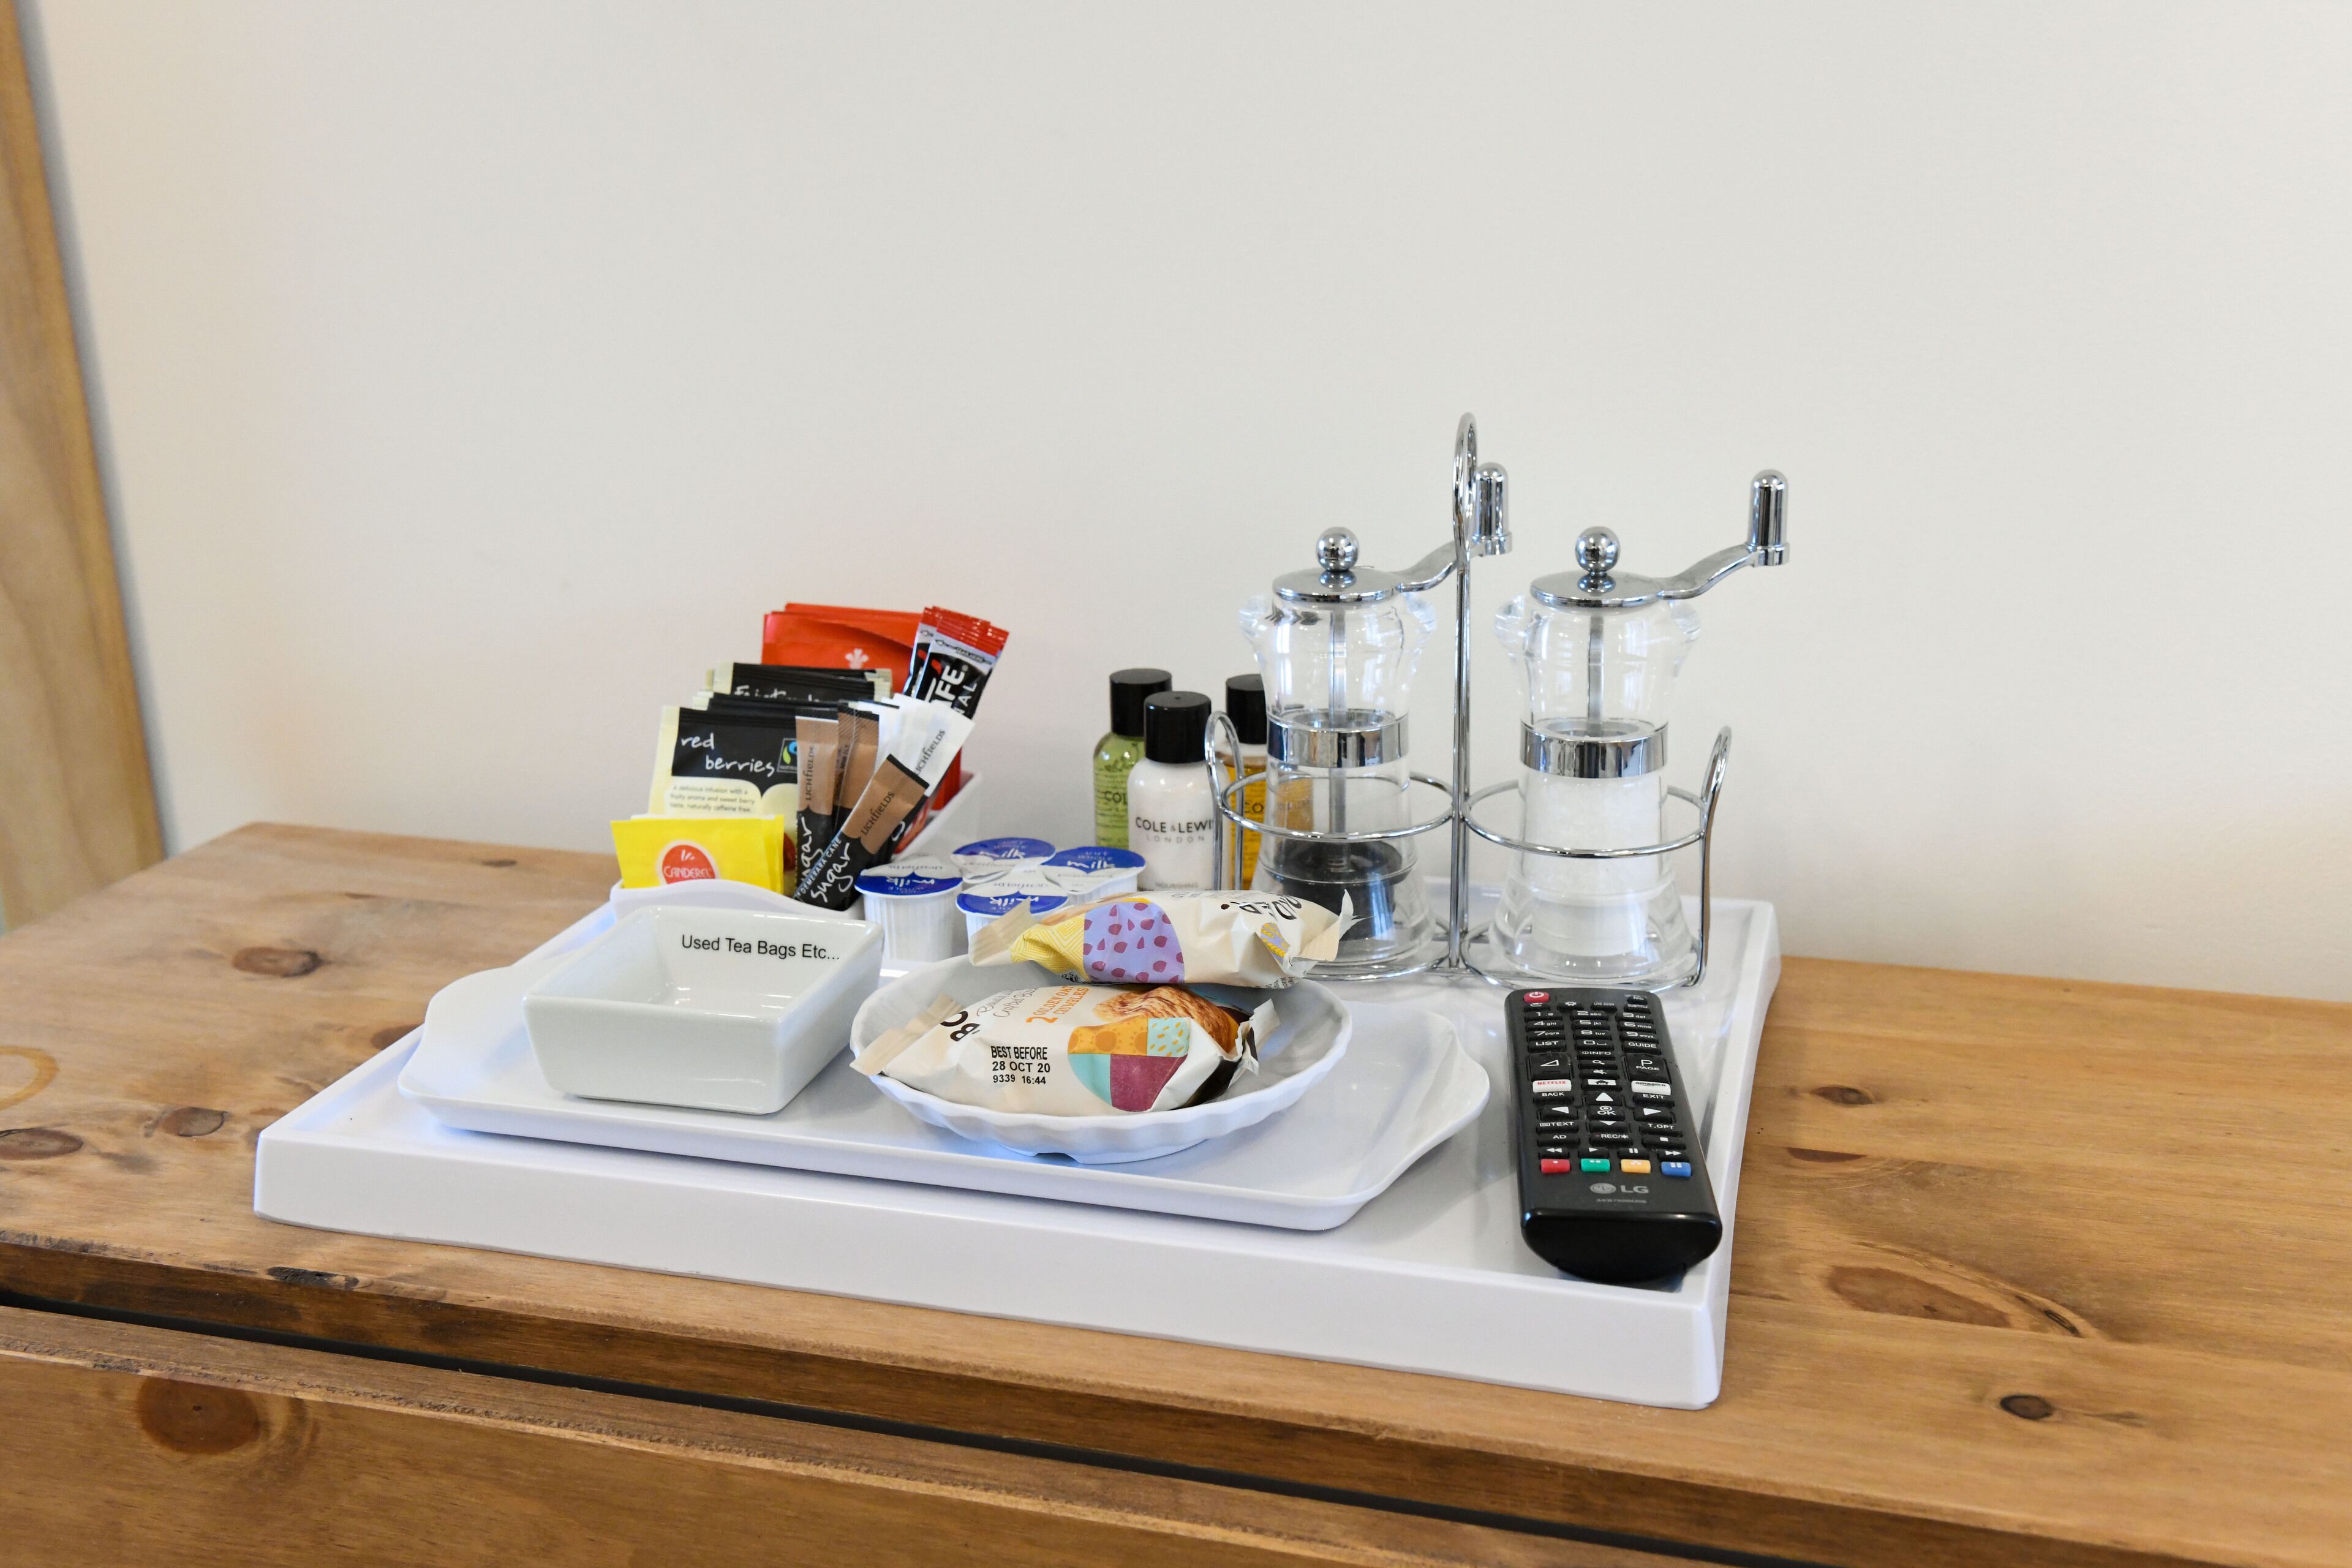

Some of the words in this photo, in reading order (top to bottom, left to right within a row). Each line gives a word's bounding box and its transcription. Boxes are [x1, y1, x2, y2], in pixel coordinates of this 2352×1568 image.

[680, 732, 715, 750] red
[705, 755, 775, 777] berries
[1136, 817, 1167, 833] COLE
[825, 837, 843, 858] CANE
[810, 842, 855, 903] sugar
[1066, 860, 1115, 869] milk
[886, 876, 935, 888] milk
[681, 934, 720, 951] Used
[725, 937, 752, 954] Tea
[757, 940, 797, 960] Bags
[801, 943, 840, 960] Etc...
[1033, 993, 1061, 1016] GOLDEN
[1053, 987, 1090, 1015] CRUMBLES
[990, 1045, 1011, 1058] BEST
[1013, 1046, 1048, 1060] BEFORE
[992, 1061, 1006, 1071] 28
[1009, 1061, 1033, 1073] OCT
[1037, 1063, 1051, 1073] 20
[992, 1074, 1016, 1084] 9339
[1022, 1075, 1047, 1085] 16:44
[1620, 1185, 1649, 1194] LG
